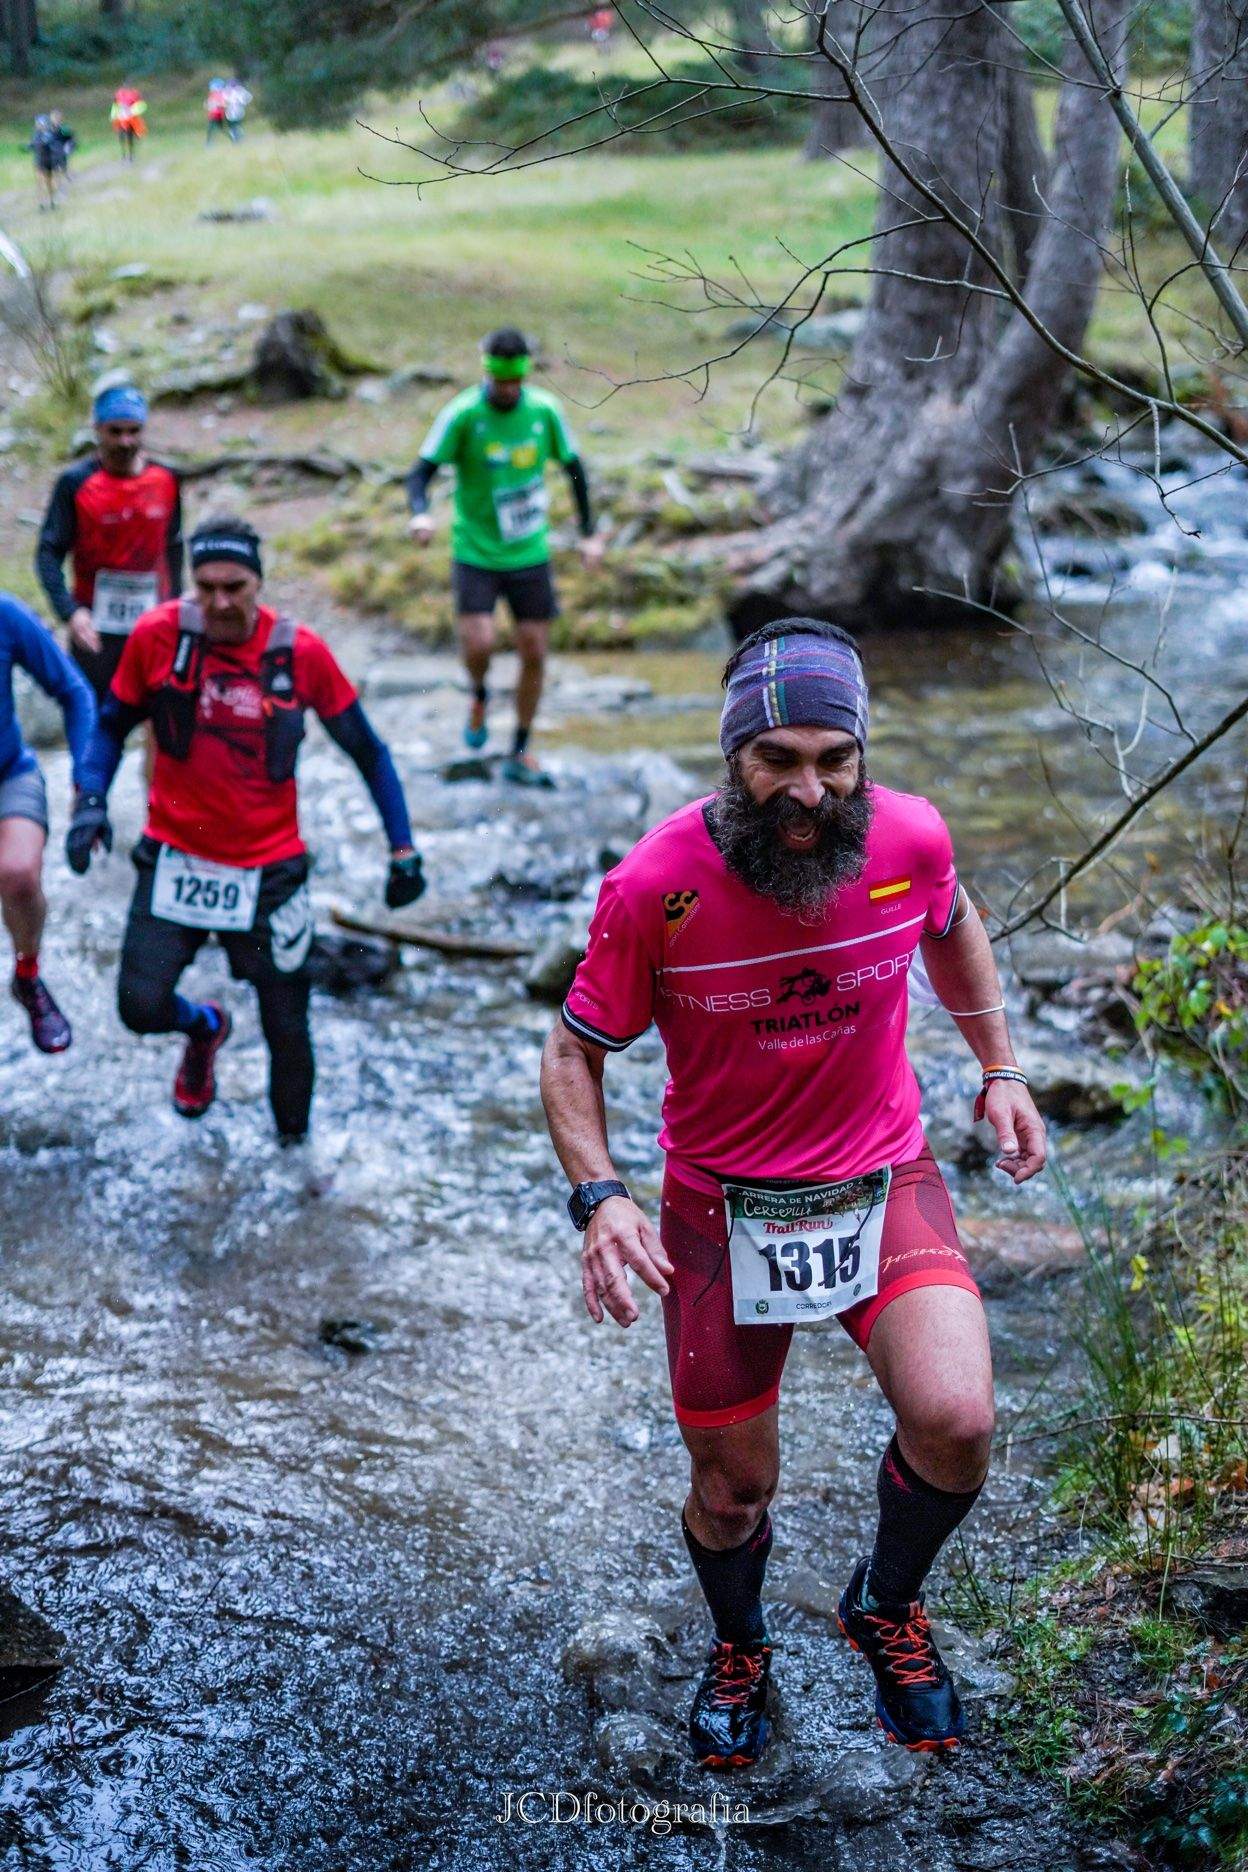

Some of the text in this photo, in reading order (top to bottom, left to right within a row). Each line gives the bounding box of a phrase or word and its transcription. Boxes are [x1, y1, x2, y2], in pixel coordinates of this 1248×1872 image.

[171, 876, 240, 910] 1259
[880, 903, 902, 915] GUILLE
[751, 1003, 861, 1035] TRIATLÓN
[758, 1024, 857, 1050] Valle de las Cañas
[738, 1189, 787, 1204] ARRERA
[804, 1181, 855, 1203] NAVIDAD
[762, 1217, 834, 1234] Trail Run
[758, 1233, 861, 1292] 1315
